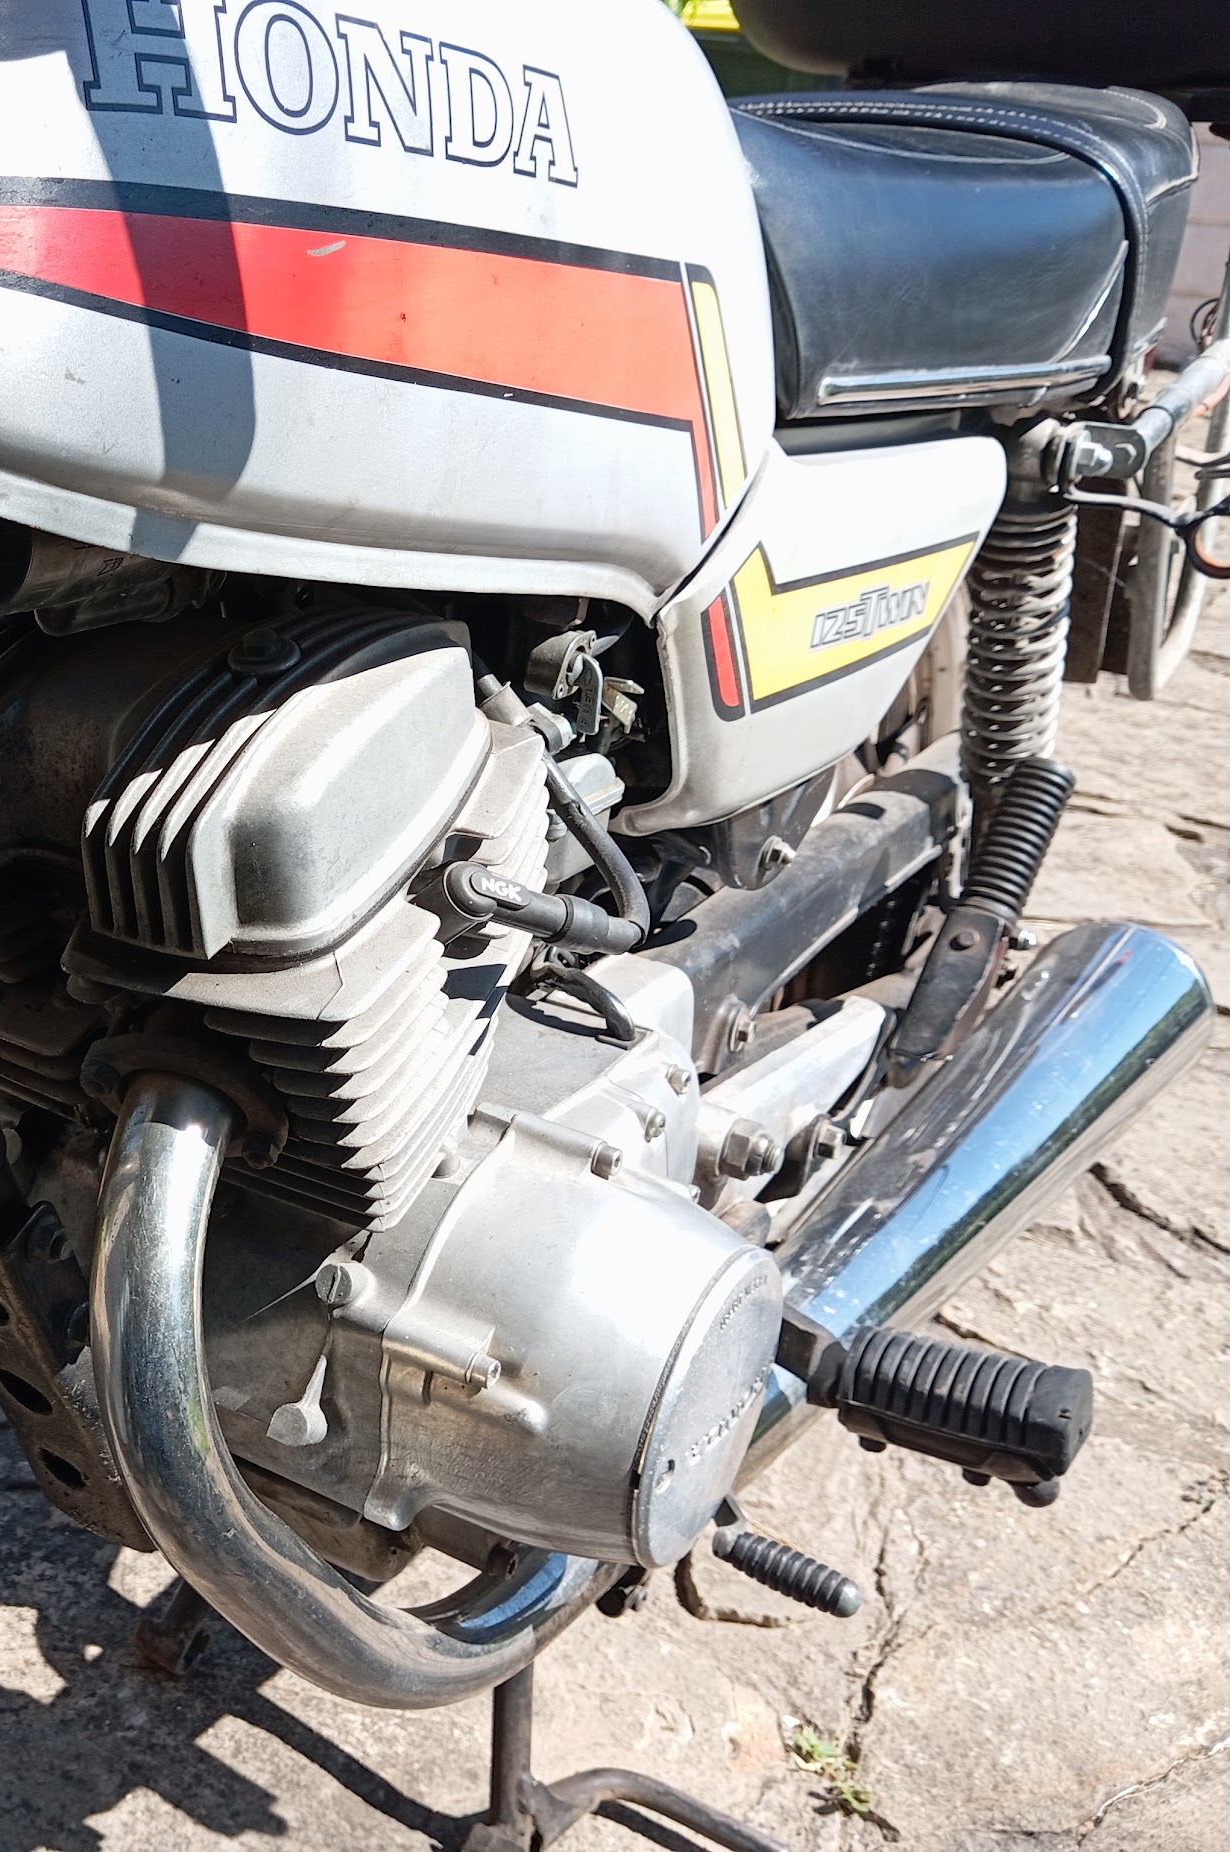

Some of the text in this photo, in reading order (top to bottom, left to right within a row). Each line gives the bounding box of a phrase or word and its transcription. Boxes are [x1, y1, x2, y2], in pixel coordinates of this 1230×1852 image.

[83, 0, 578, 187] HONDA
[579, 687, 595, 726] FUEL
[481, 877, 522, 902] NGK
